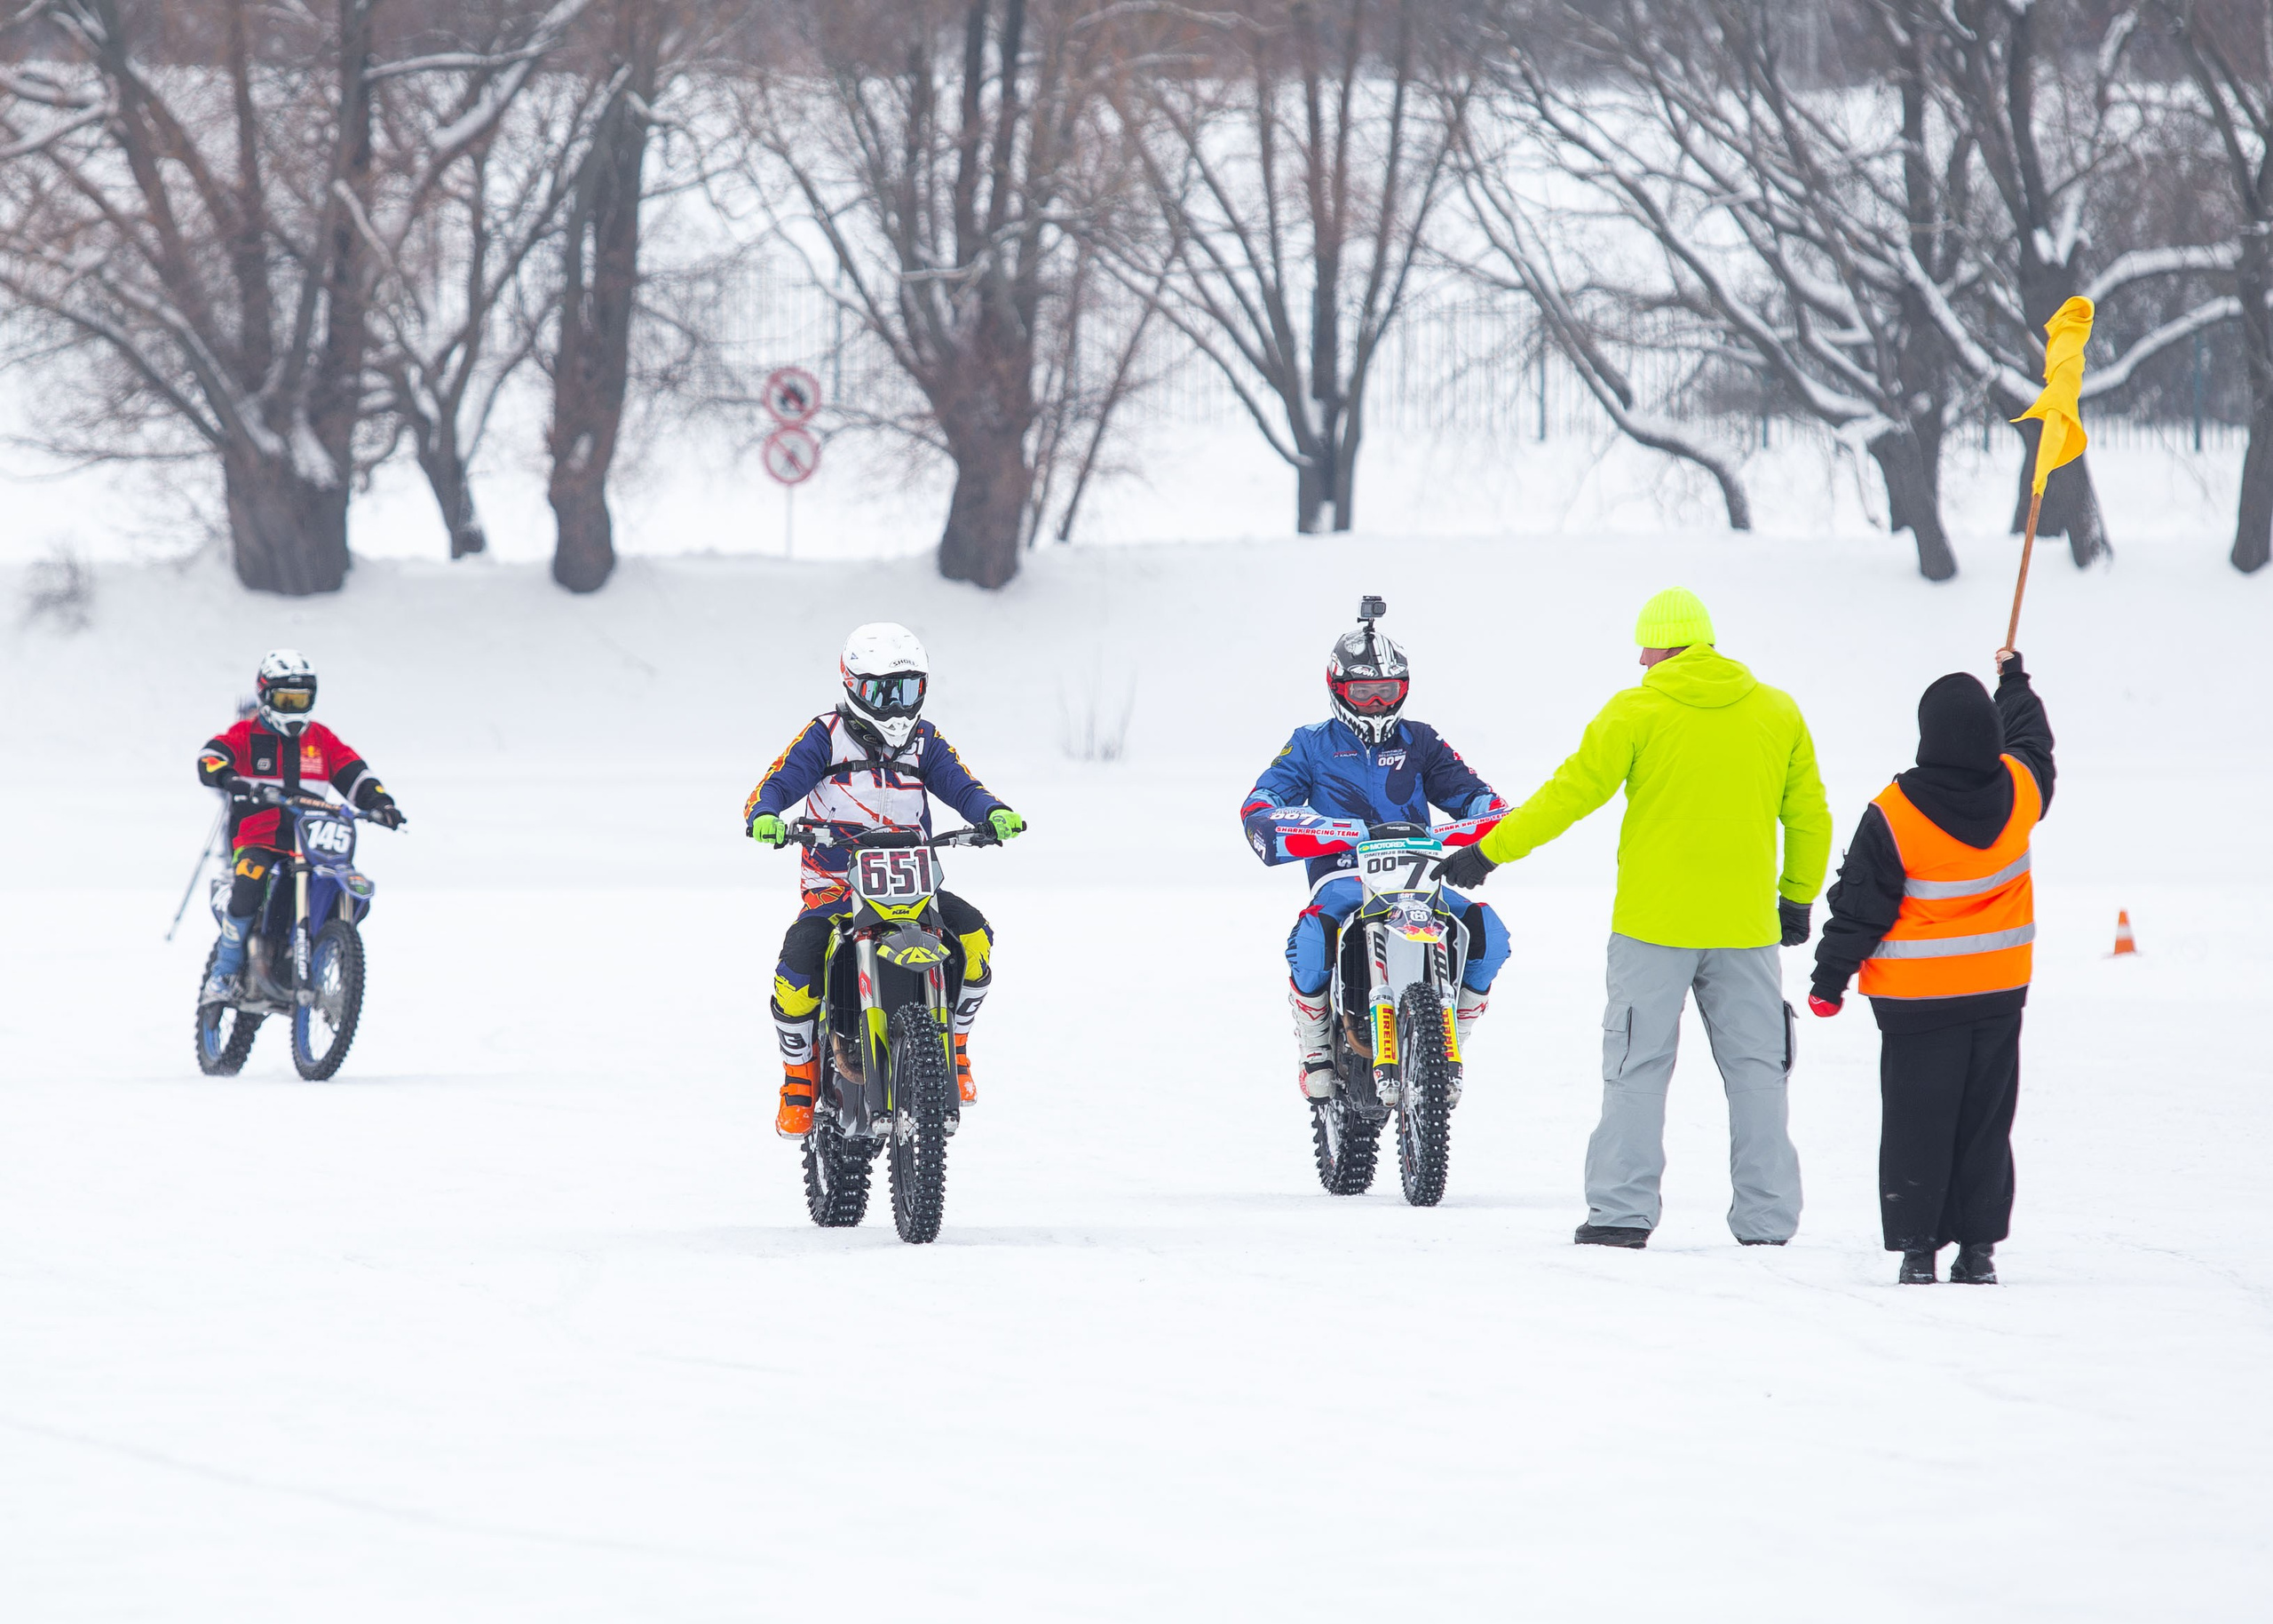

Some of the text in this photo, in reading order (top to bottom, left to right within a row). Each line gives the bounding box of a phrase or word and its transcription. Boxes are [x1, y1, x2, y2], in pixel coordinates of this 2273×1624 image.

[1378, 755, 1406, 770] 007
[307, 820, 353, 853] 145
[1434, 824, 1461, 834] SHARK
[1461, 816, 1491, 827] RACING
[859, 846, 933, 898] 651
[1366, 855, 1430, 890] 007
[1373, 931, 1389, 983] WP
[1382, 1007, 1396, 1060] PIRELLI
